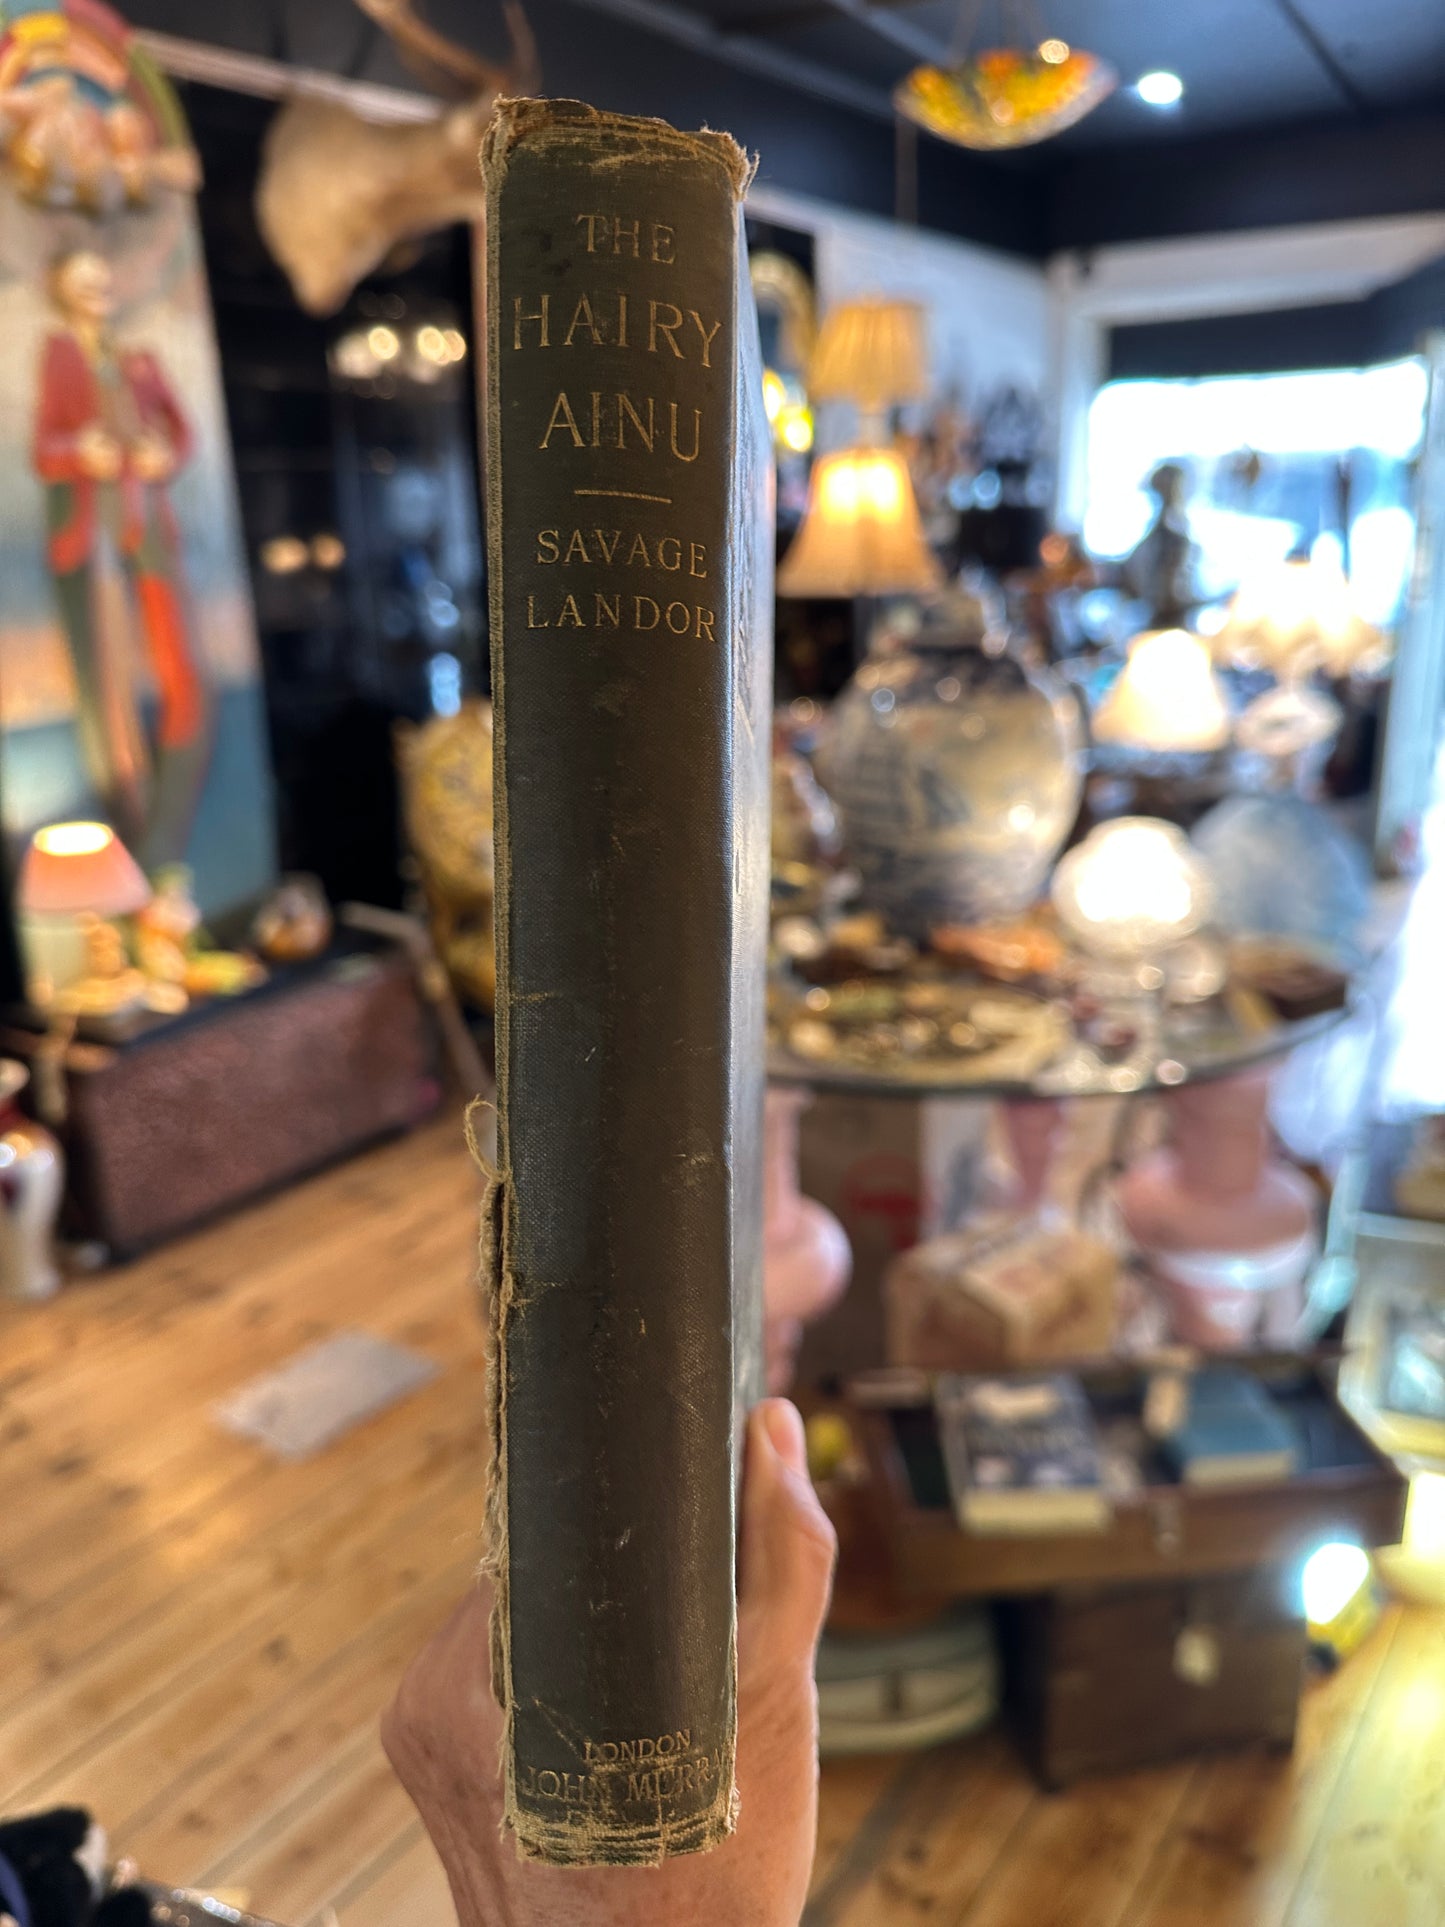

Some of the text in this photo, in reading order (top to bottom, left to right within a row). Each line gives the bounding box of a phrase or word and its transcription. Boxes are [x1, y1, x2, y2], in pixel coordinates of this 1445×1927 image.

[575, 213, 676, 265] THE
[512, 292, 722, 368] HAIRY
[539, 391, 702, 462] AINU
[536, 529, 708, 579] SAVAGE
[526, 593, 716, 643] LANDOR
[583, 1728, 691, 1764] LONDON
